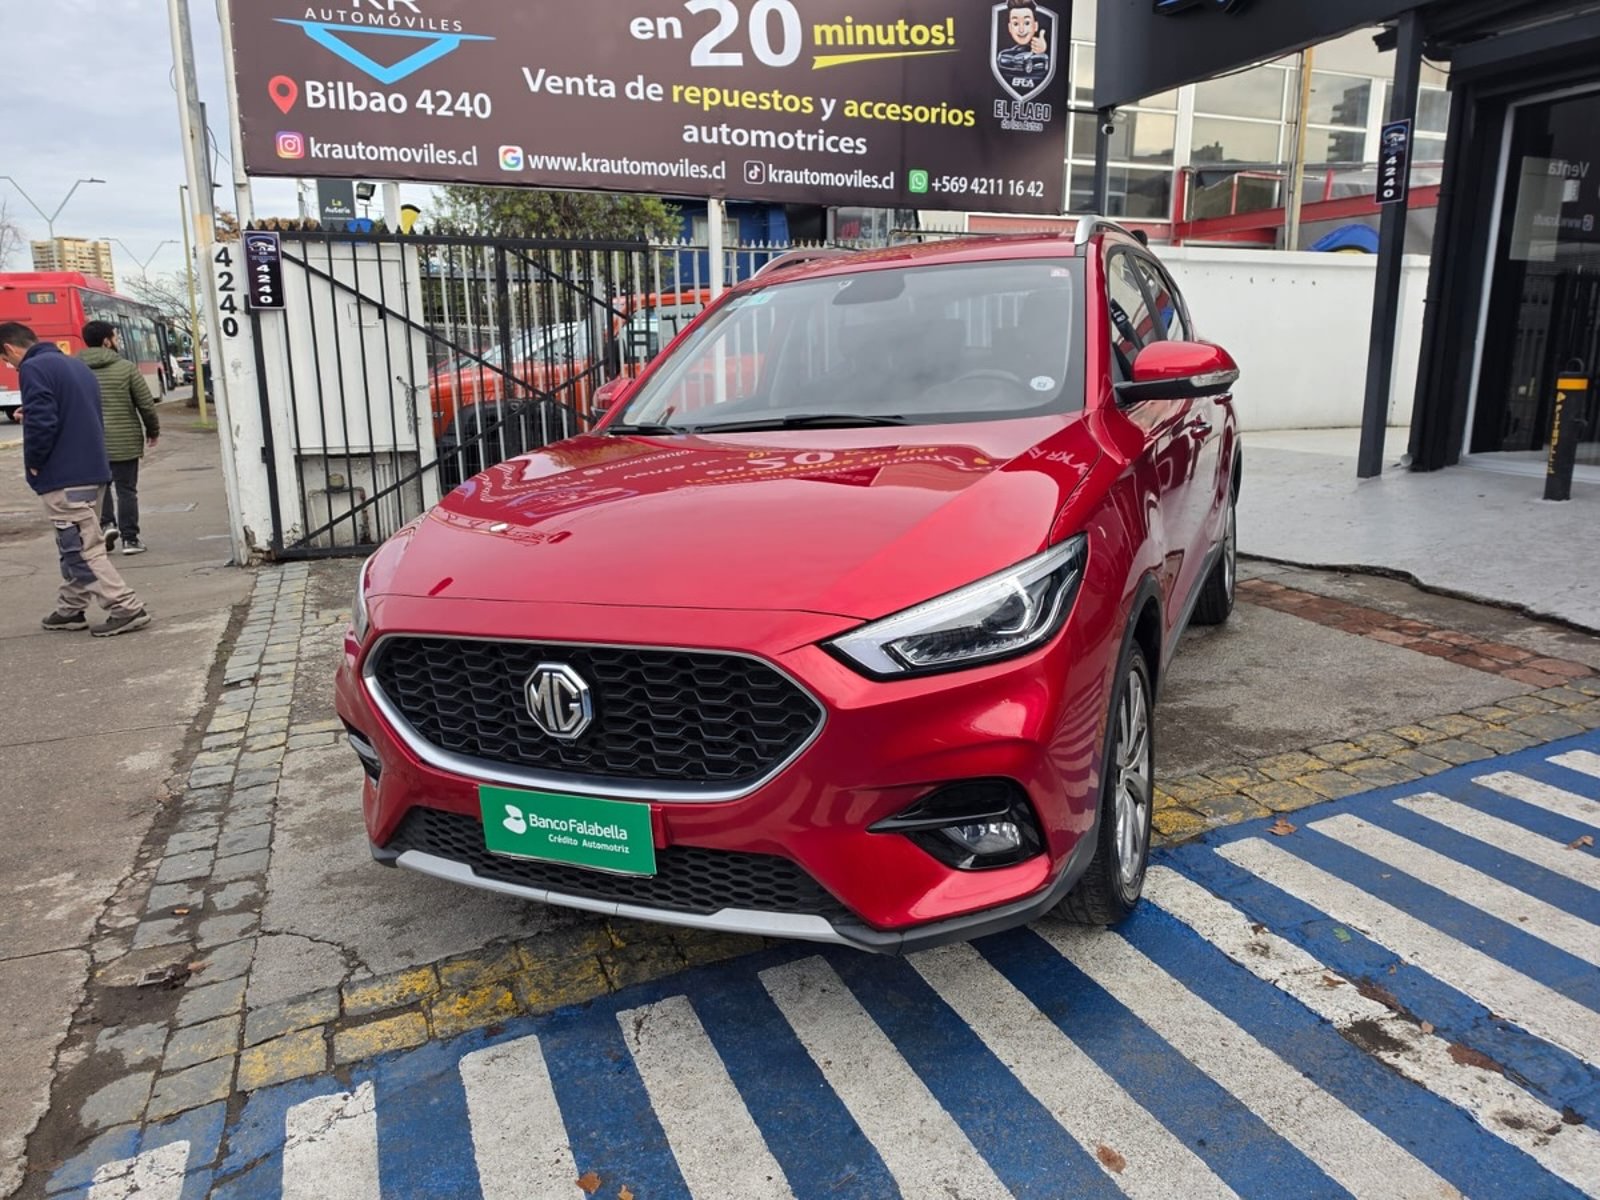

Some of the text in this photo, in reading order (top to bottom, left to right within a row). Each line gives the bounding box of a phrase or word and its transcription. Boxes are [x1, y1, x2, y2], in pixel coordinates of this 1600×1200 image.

[304, 7, 463, 32] AUTOMÓVILES
[629, 0, 956, 67] en 20 minutos!
[304, 80, 493, 118] Bilbao 4240
[521, 66, 976, 127] Venta de repuestos y accesorios
[993, 99, 1052, 122] EL FLACO
[309, 136, 478, 166] krautomoviles.cl
[682, 122, 868, 155] automotrices
[528, 152, 726, 180] www.krautomoviles.cl
[768, 163, 895, 190] krautomoviles.cl
[1383, 155, 1397, 198] 4240
[931, 175, 1044, 197] +569 4211 16 42
[214, 246, 239, 338] 4240
[256, 264, 273, 304] 4240
[530, 672, 581, 732] MG
[528, 813, 628, 840] Banco Falabella
[548, 834, 630, 854] Crédito Automotriz
